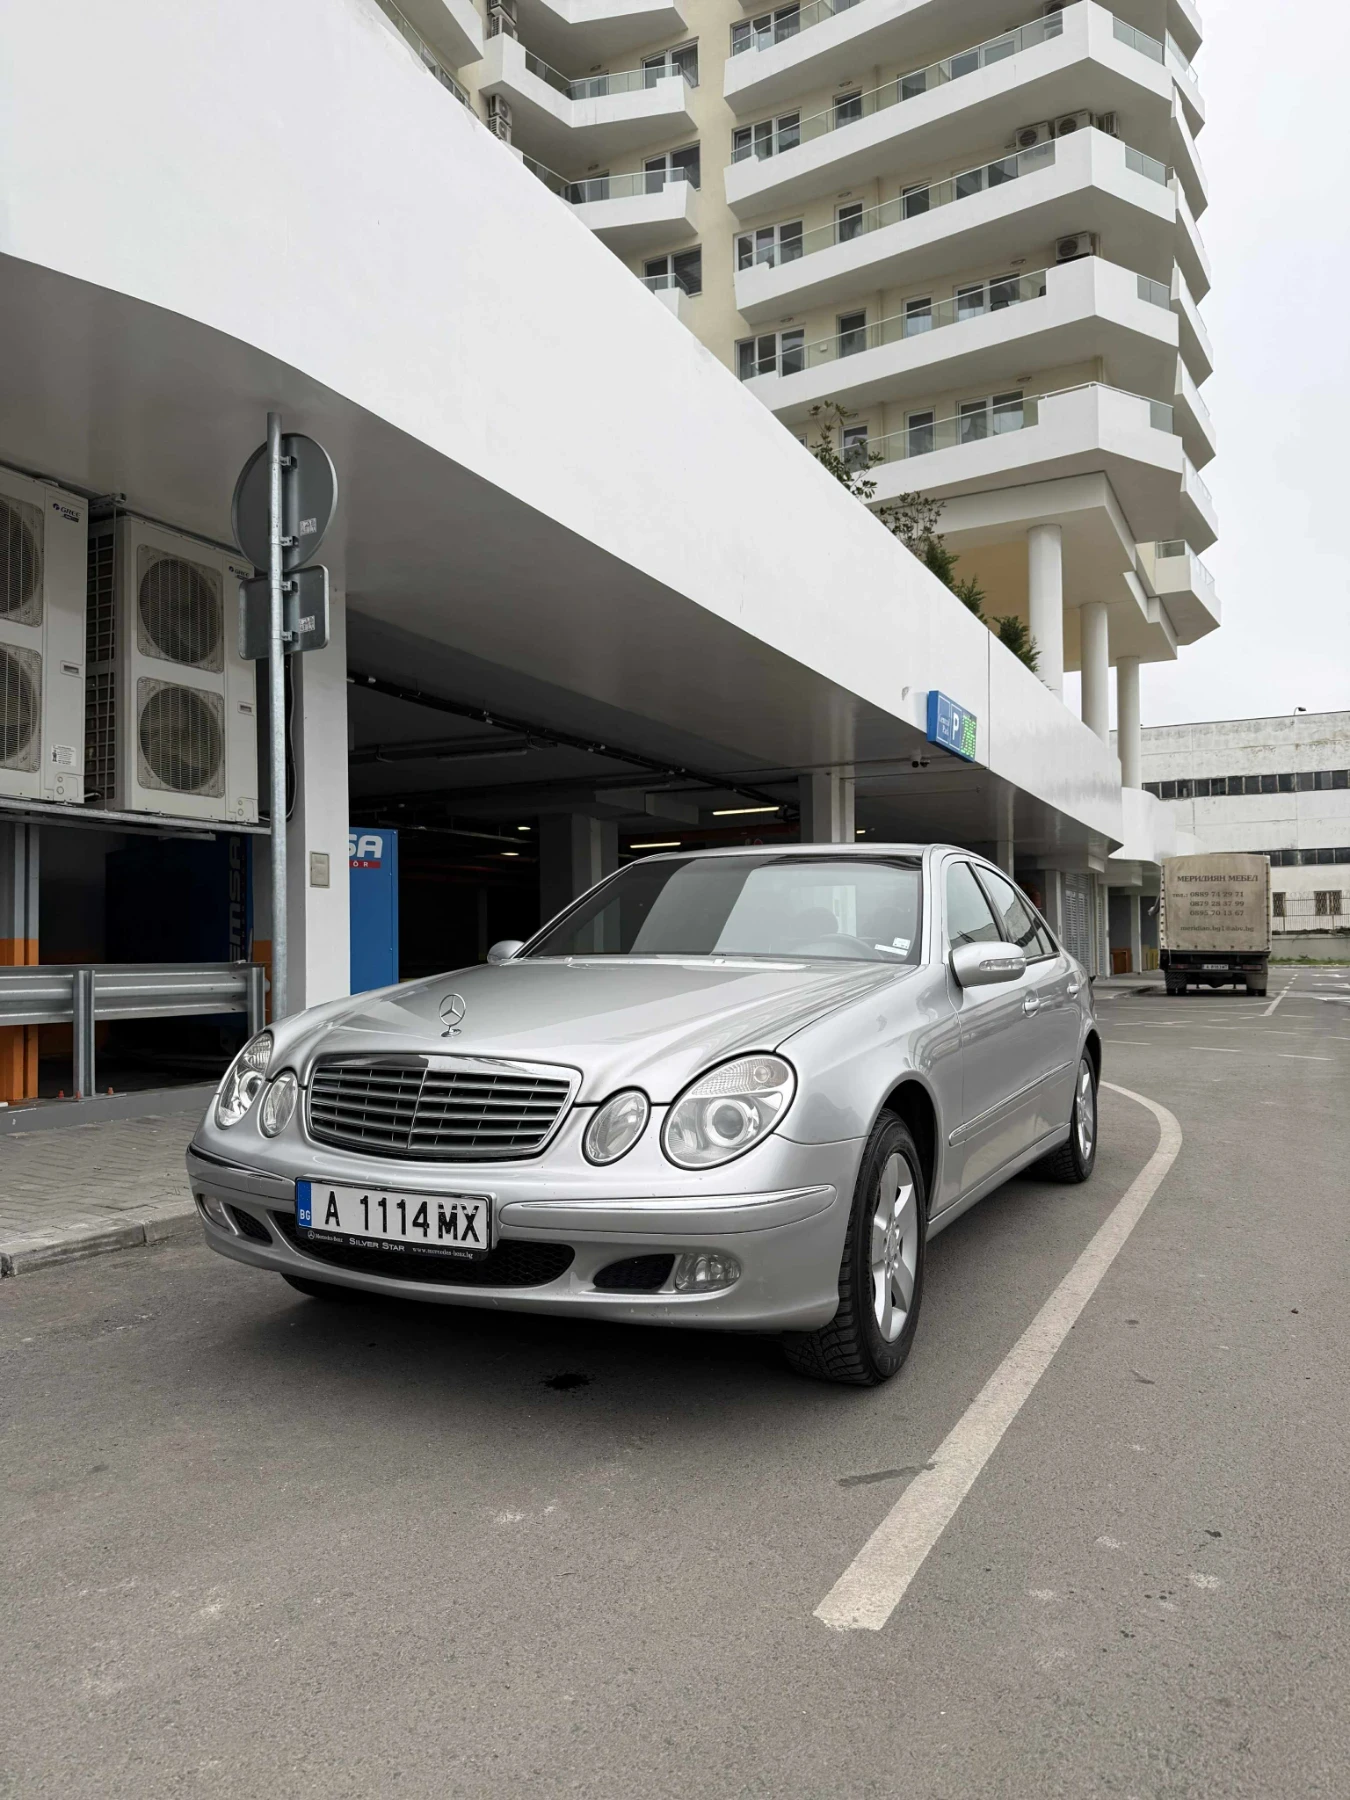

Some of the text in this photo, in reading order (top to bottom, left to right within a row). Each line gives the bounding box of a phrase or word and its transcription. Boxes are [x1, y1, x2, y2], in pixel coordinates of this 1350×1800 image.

[952, 712, 960, 740] P
[1177, 874, 1259, 883] МЕРИДИЯН МЕБЕЛ
[300, 1209, 311, 1221] BG
[325, 1191, 340, 1227] A
